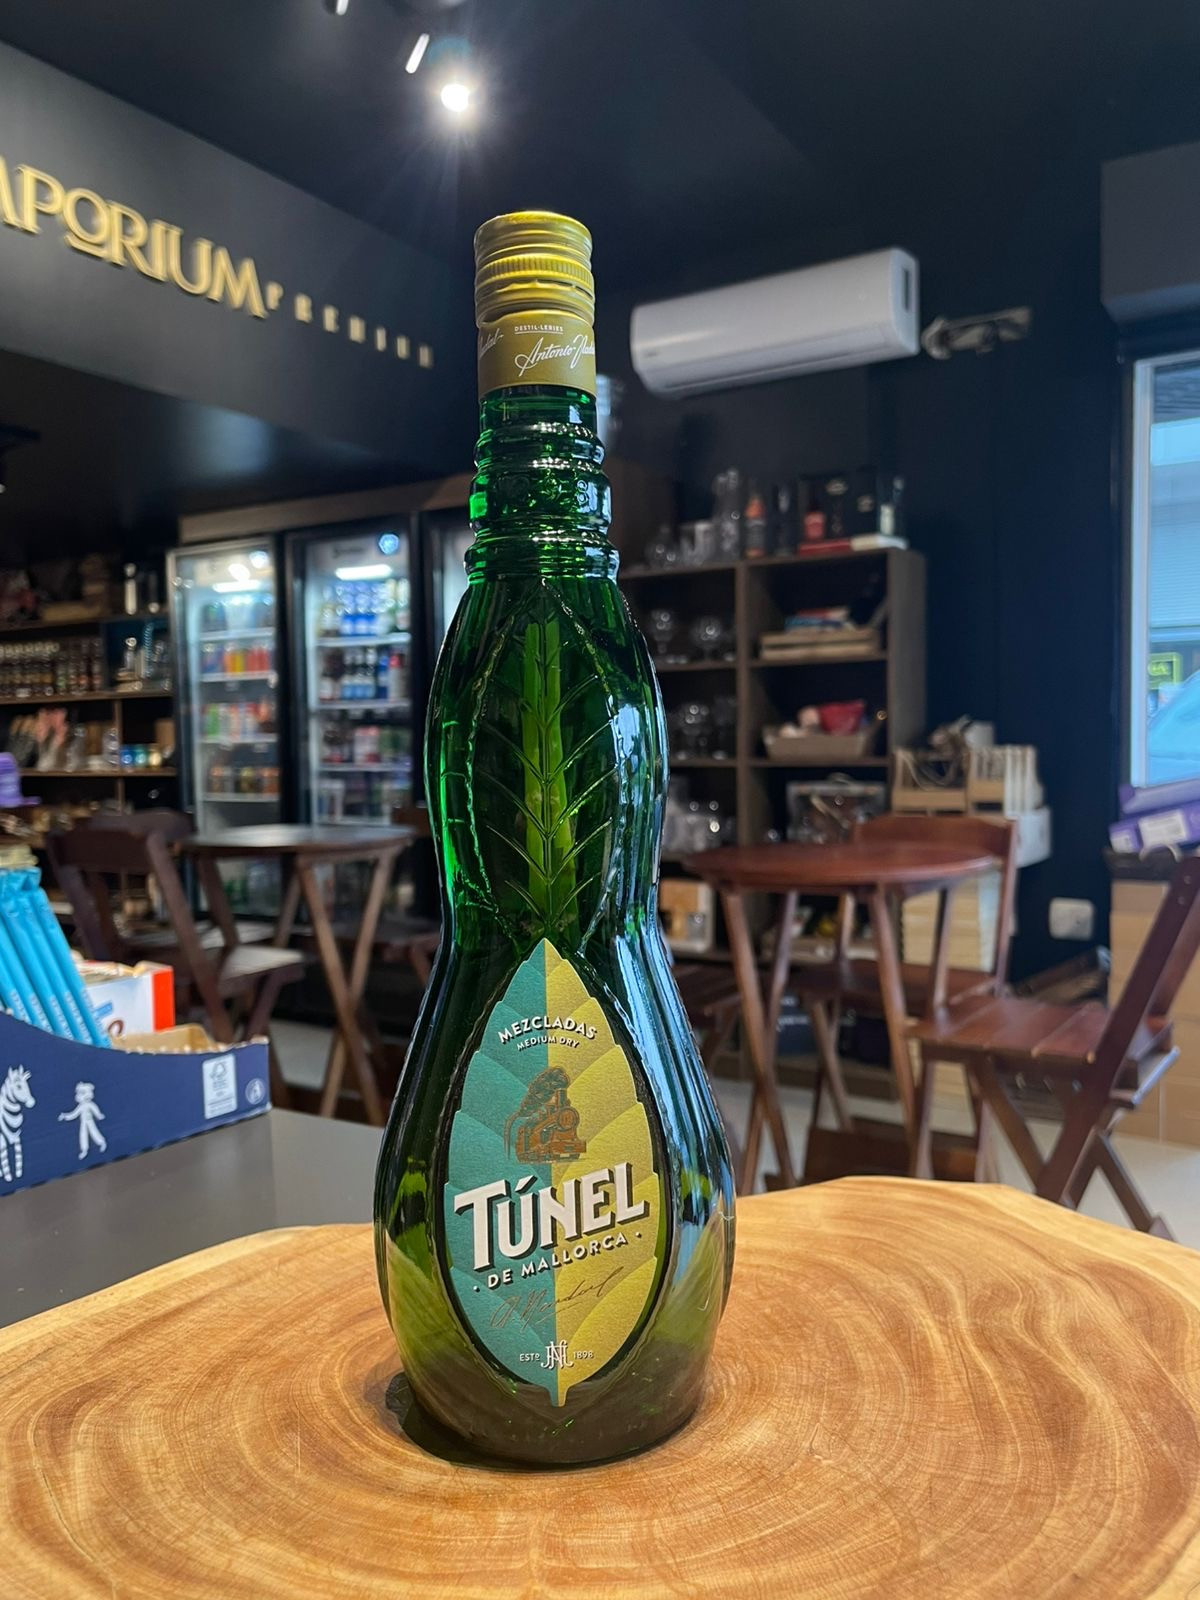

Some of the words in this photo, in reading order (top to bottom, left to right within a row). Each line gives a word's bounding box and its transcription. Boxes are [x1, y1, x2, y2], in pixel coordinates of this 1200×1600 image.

[514, 336, 575, 377] Antonio
[497, 1015, 597, 1045] MEZCLADAS
[516, 1035, 557, 1051] MEDIUM
[559, 1036, 580, 1049] DRY
[453, 1161, 650, 1272] TÚNEL
[487, 1268, 514, 1290] DE
[521, 1231, 630, 1280] MALLORCA
[573, 1350, 595, 1361] 1898
